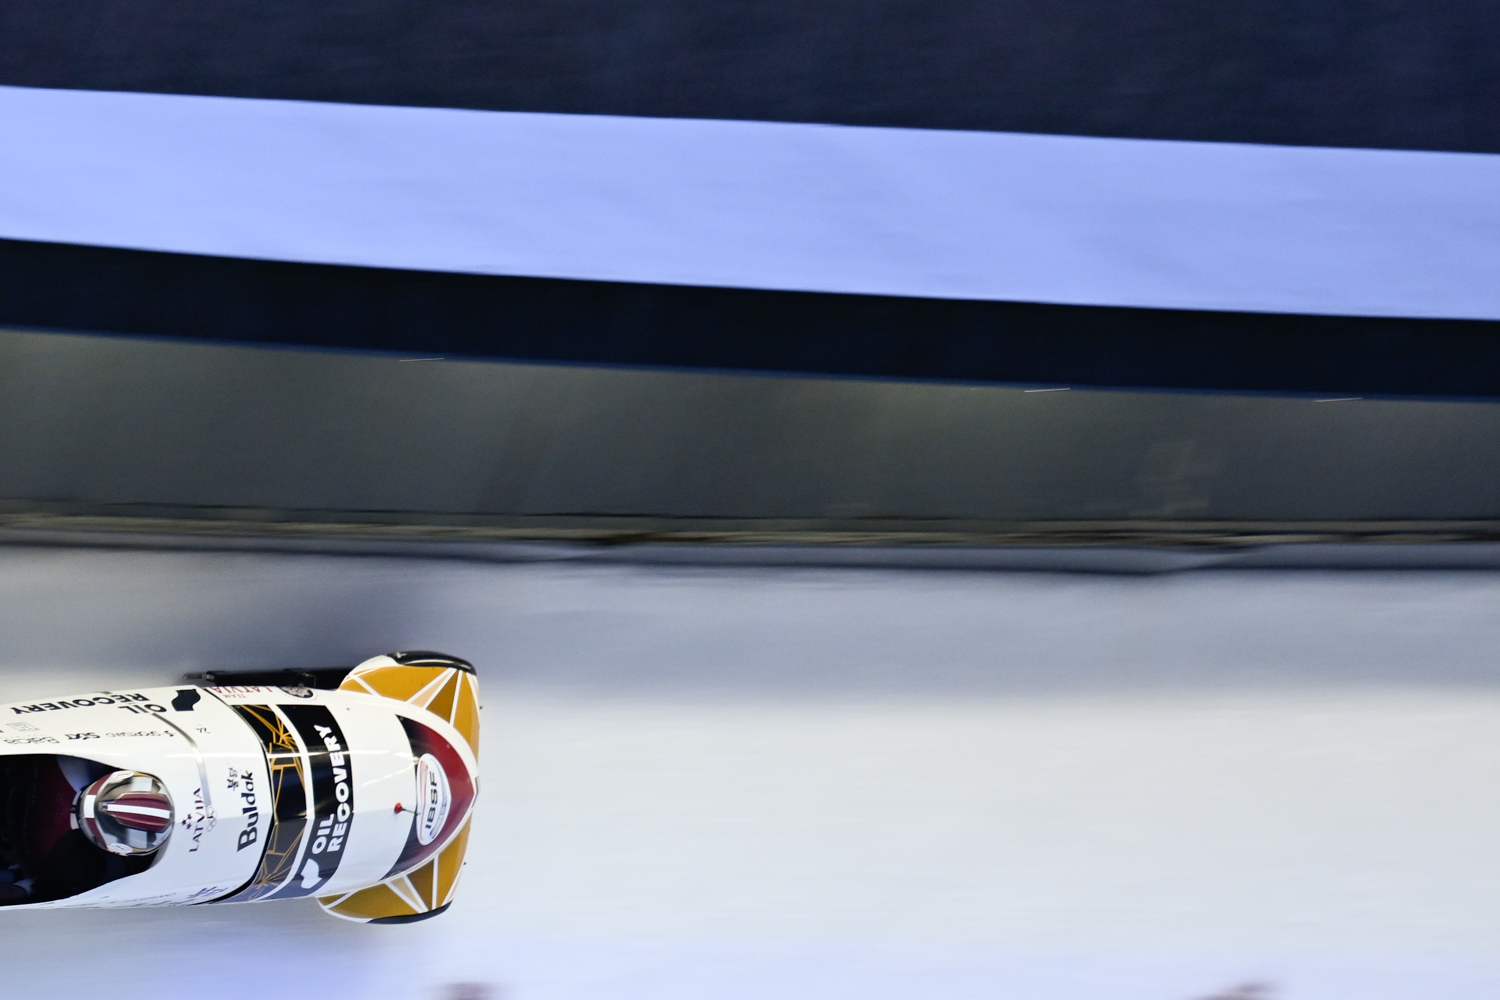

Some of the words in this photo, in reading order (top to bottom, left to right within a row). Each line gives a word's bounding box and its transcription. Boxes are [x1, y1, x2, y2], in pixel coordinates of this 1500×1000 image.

[10, 692, 150, 714] RECOVERY
[118, 703, 167, 714] OIL
[237, 770, 258, 852] Buldak
[313, 724, 350, 852] RECOVERY
[425, 770, 438, 829] IBSF
[188, 787, 206, 853] LATVIJA
[311, 814, 335, 855] OIL
